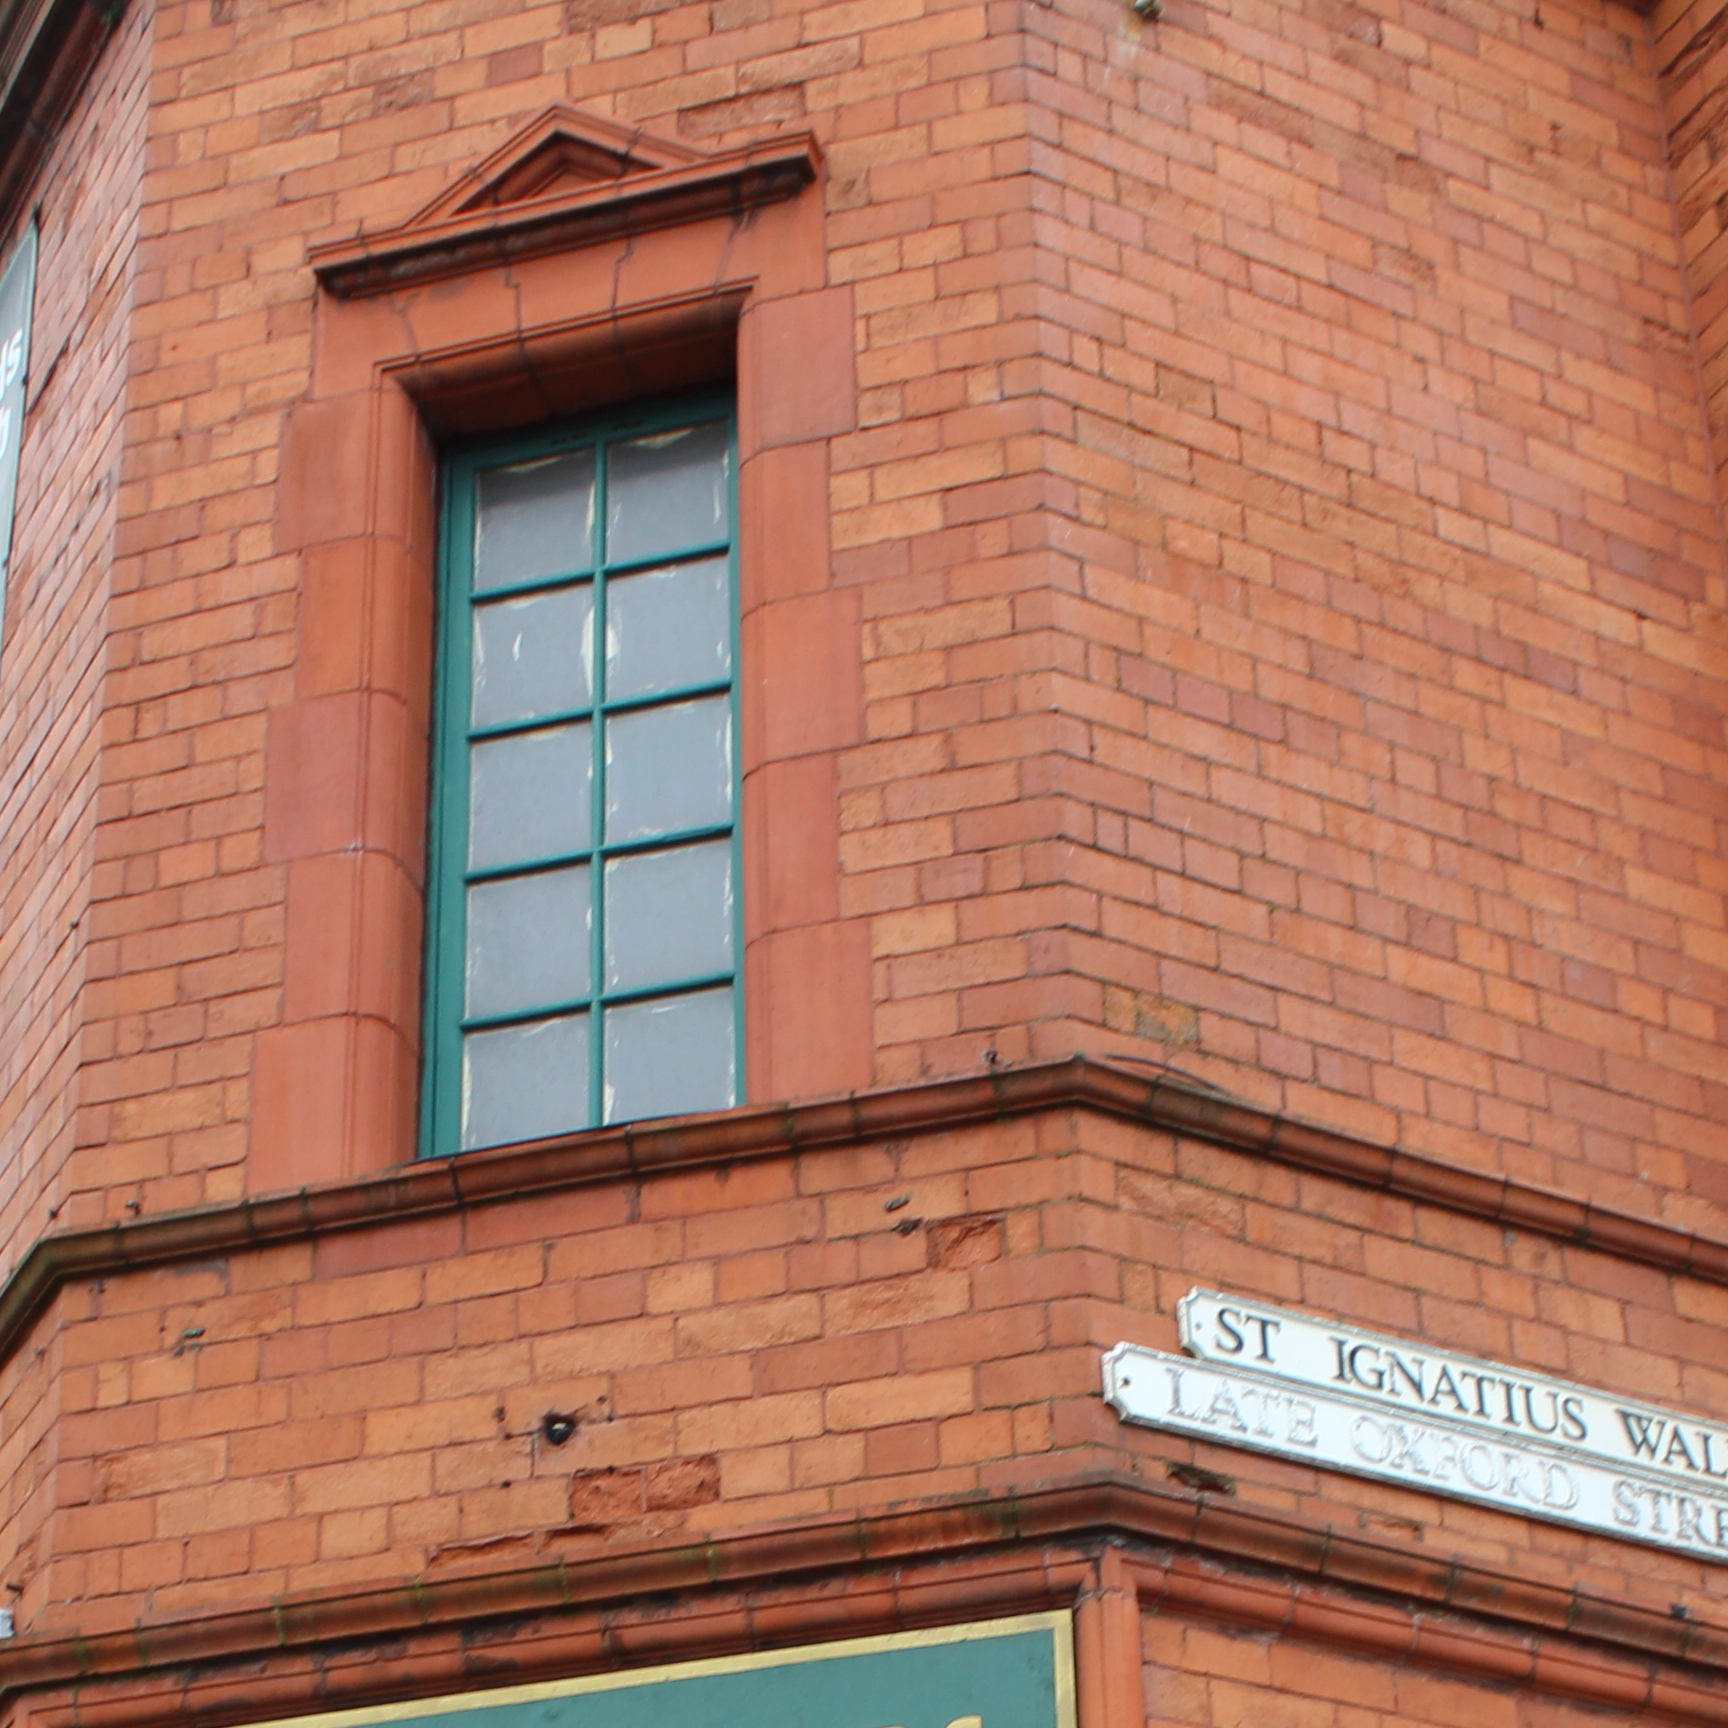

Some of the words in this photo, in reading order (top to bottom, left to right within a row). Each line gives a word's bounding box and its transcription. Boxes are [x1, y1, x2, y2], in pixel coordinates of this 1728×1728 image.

[1165, 1368, 1319, 1446] LATE
[1351, 1416, 1578, 1510] OXFORD
[1216, 1307, 1281, 1362] ST
[1332, 1336, 1588, 1442] IGNATIUS
